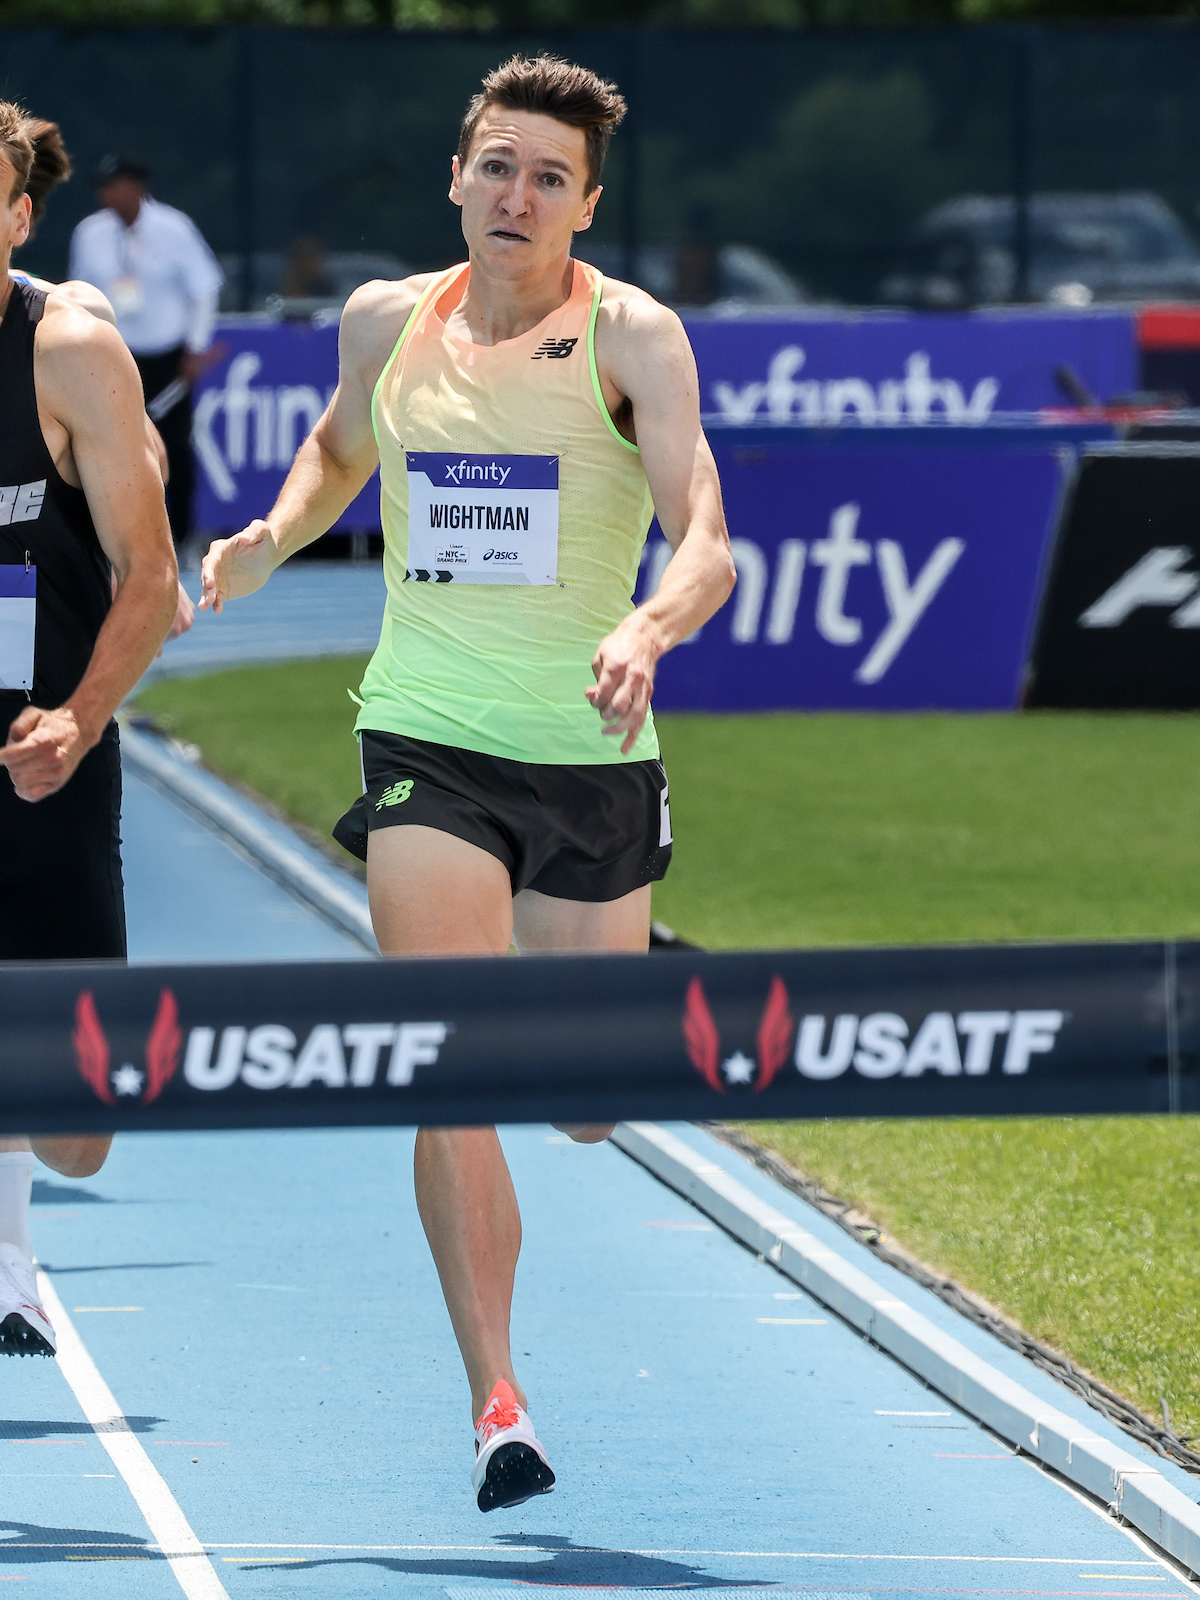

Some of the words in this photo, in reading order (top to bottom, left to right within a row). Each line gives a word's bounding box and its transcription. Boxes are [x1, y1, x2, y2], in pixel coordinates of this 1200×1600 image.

[445, 460, 512, 486] xfinity
[429, 503, 529, 531] WIGHTMAN
[445, 550, 459, 558] NYC
[184, 1022, 447, 1091] USATF
[795, 1010, 1065, 1080] USATF
